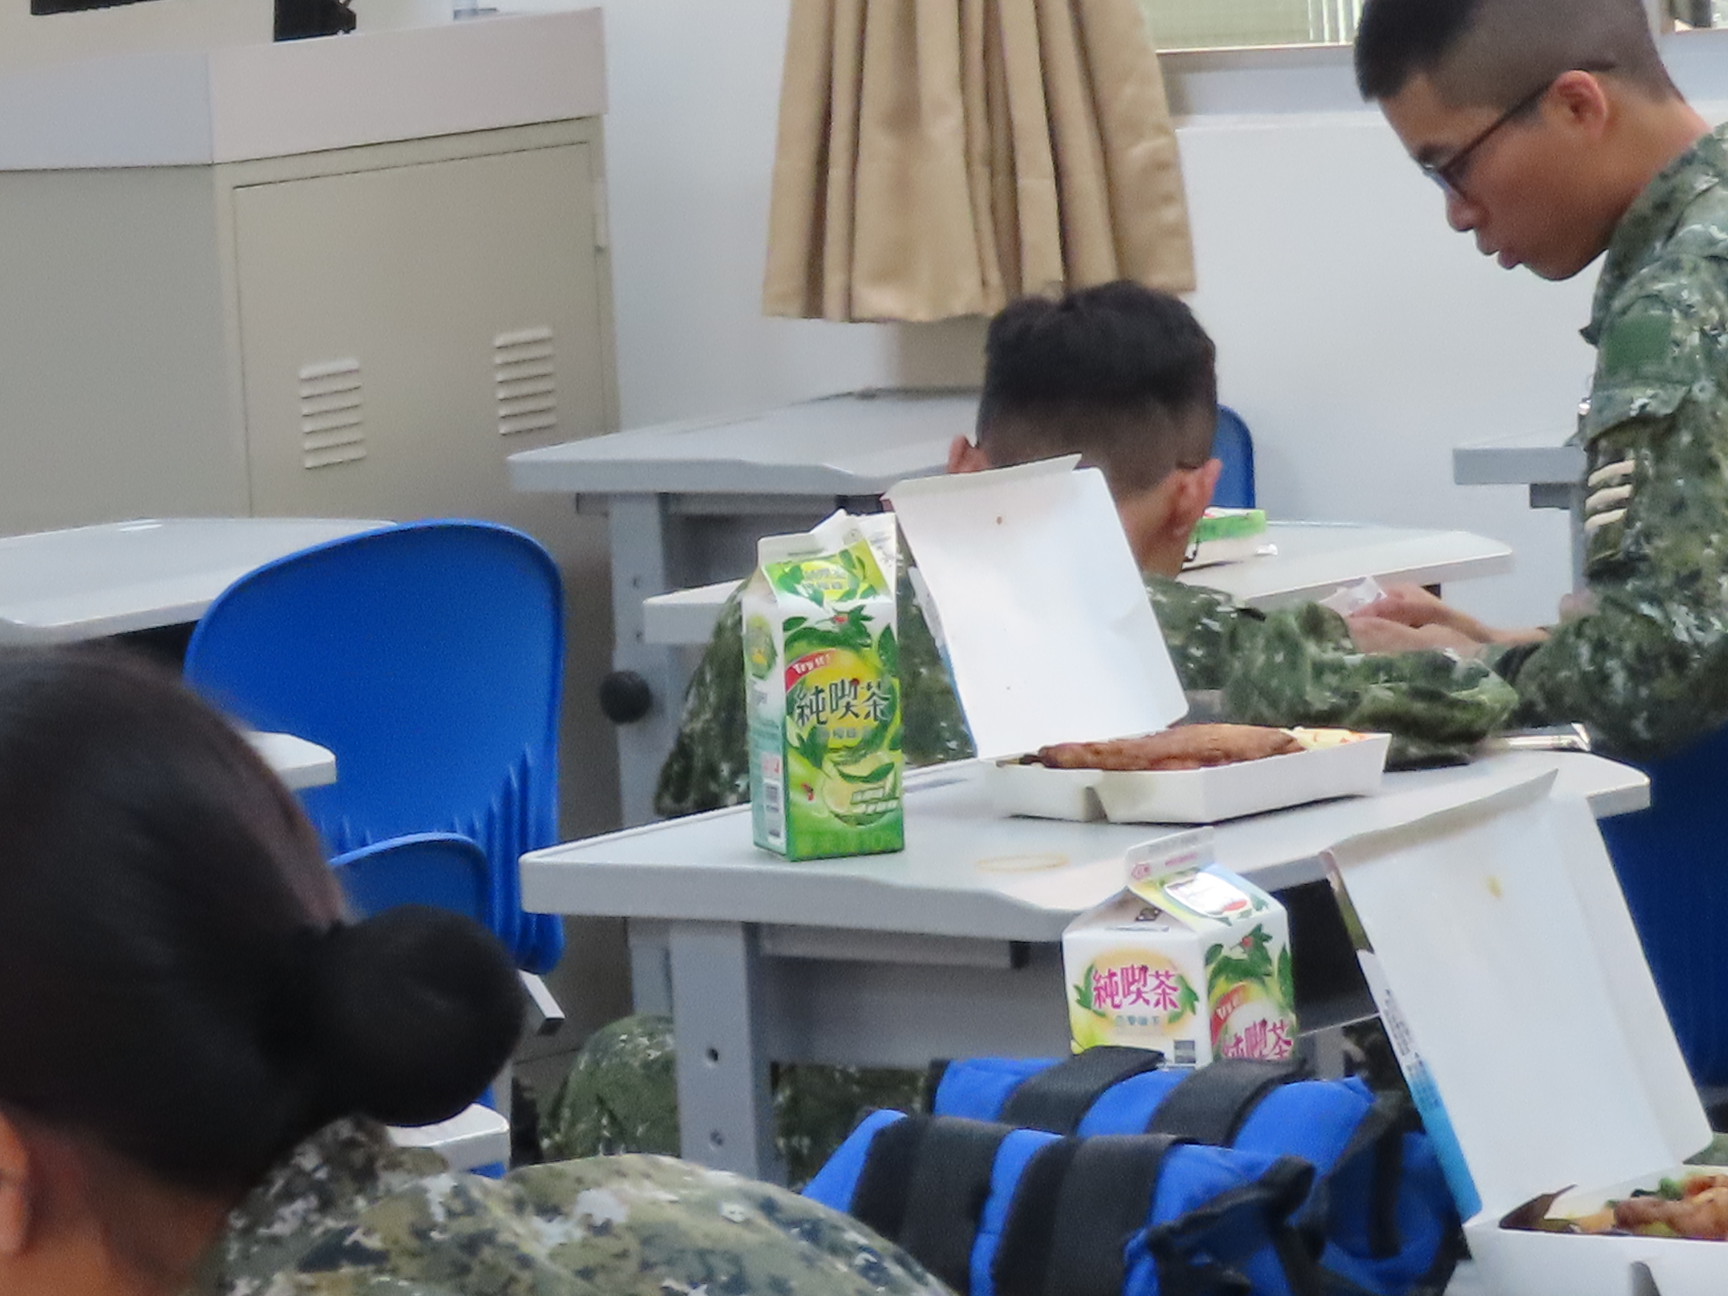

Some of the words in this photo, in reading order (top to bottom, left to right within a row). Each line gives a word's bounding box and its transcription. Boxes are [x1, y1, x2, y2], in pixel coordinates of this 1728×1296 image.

[794, 677, 892, 727] 純喫茶
[1093, 963, 1180, 1011] 純喫茶
